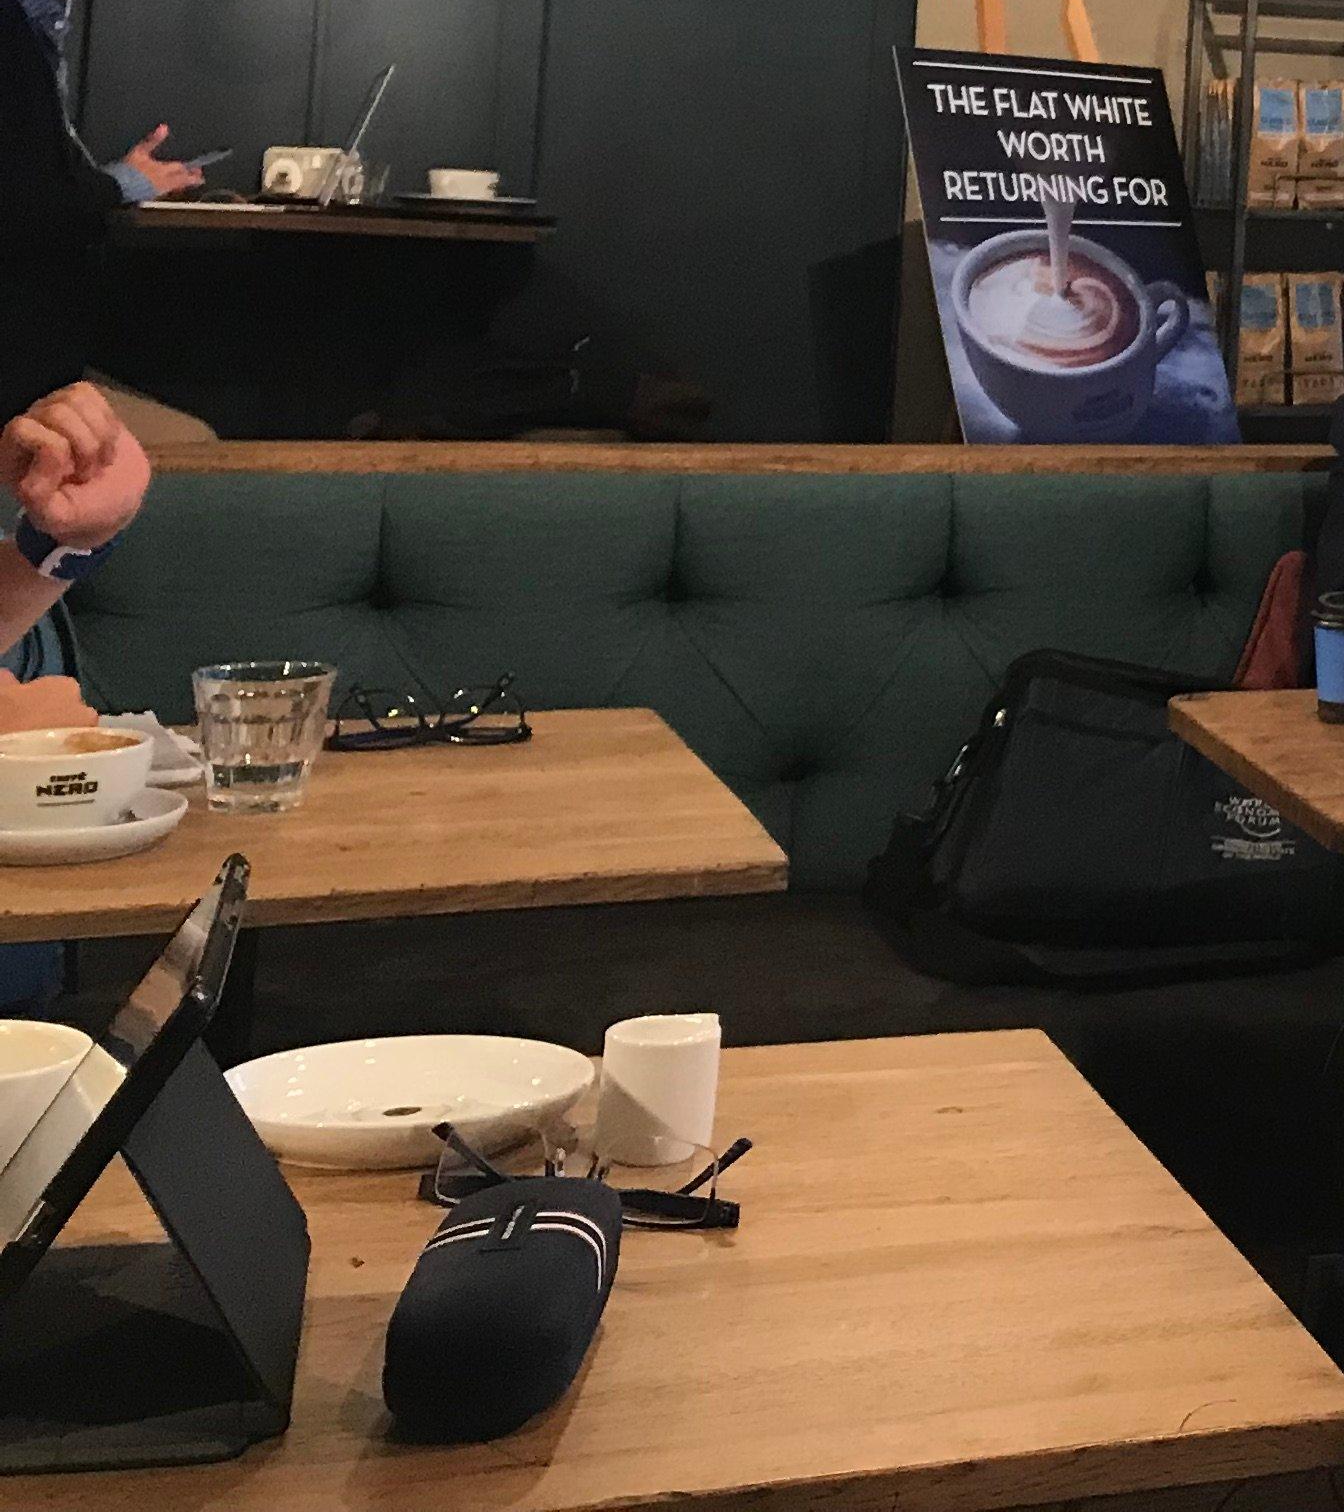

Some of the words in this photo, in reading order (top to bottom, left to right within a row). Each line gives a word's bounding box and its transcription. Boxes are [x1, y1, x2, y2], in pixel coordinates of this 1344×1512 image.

[926, 83, 989, 117] THE
[992, 87, 1058, 120] FLAT
[1062, 91, 1153, 127] WHITE
[996, 129, 1106, 164] WORTH
[942, 170, 1110, 205] RETURNING
[1112, 176, 1169, 207] FOR
[35, 781, 99, 797] NERO
